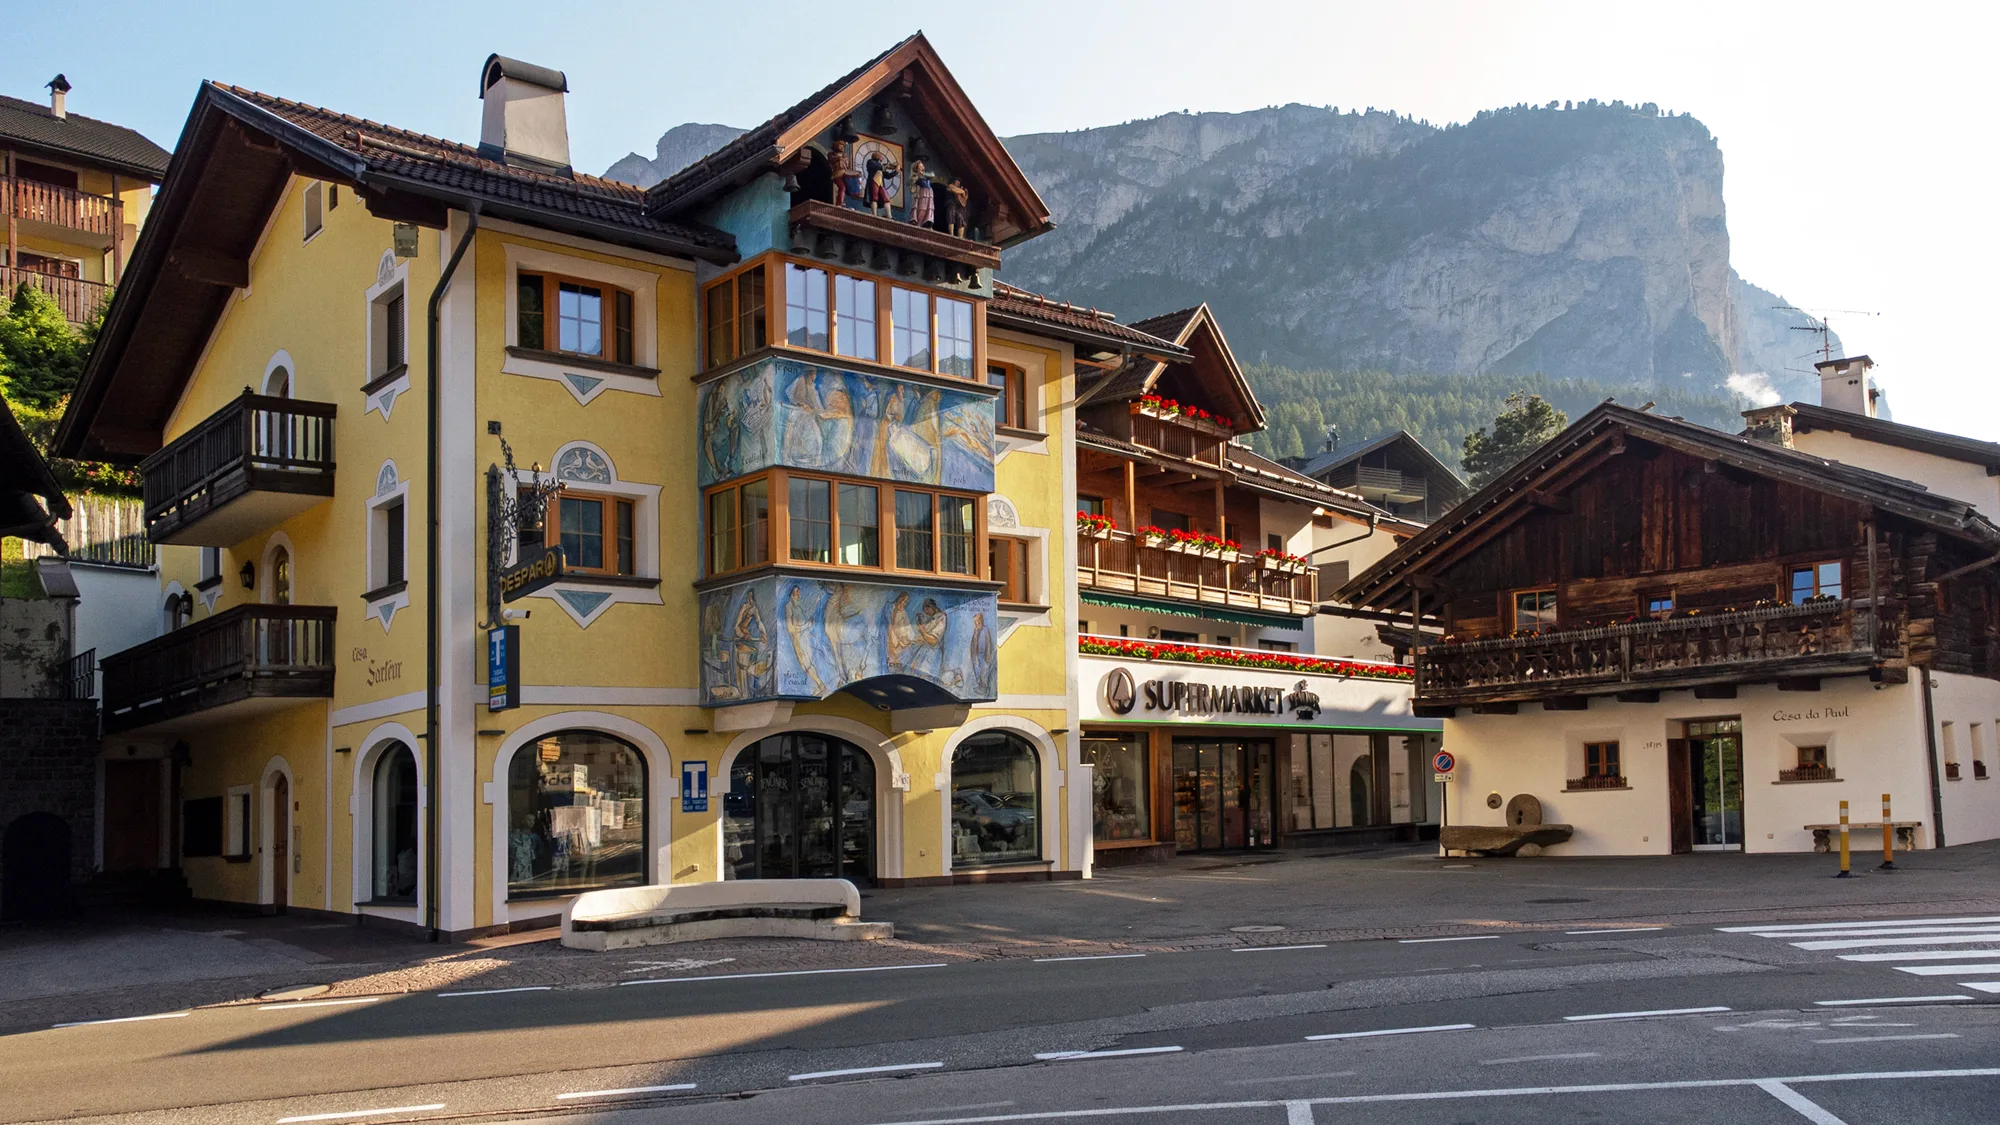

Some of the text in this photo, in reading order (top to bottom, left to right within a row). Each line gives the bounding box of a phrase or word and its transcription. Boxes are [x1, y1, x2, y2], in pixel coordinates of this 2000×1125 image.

[501, 561, 545, 594] DESPAR
[491, 629, 505, 666] T
[1144, 680, 1285, 715] SUPERMARKET
[1805, 708, 1820, 720] da
[1825, 705, 1849, 719] Paul
[684, 763, 706, 799] T
